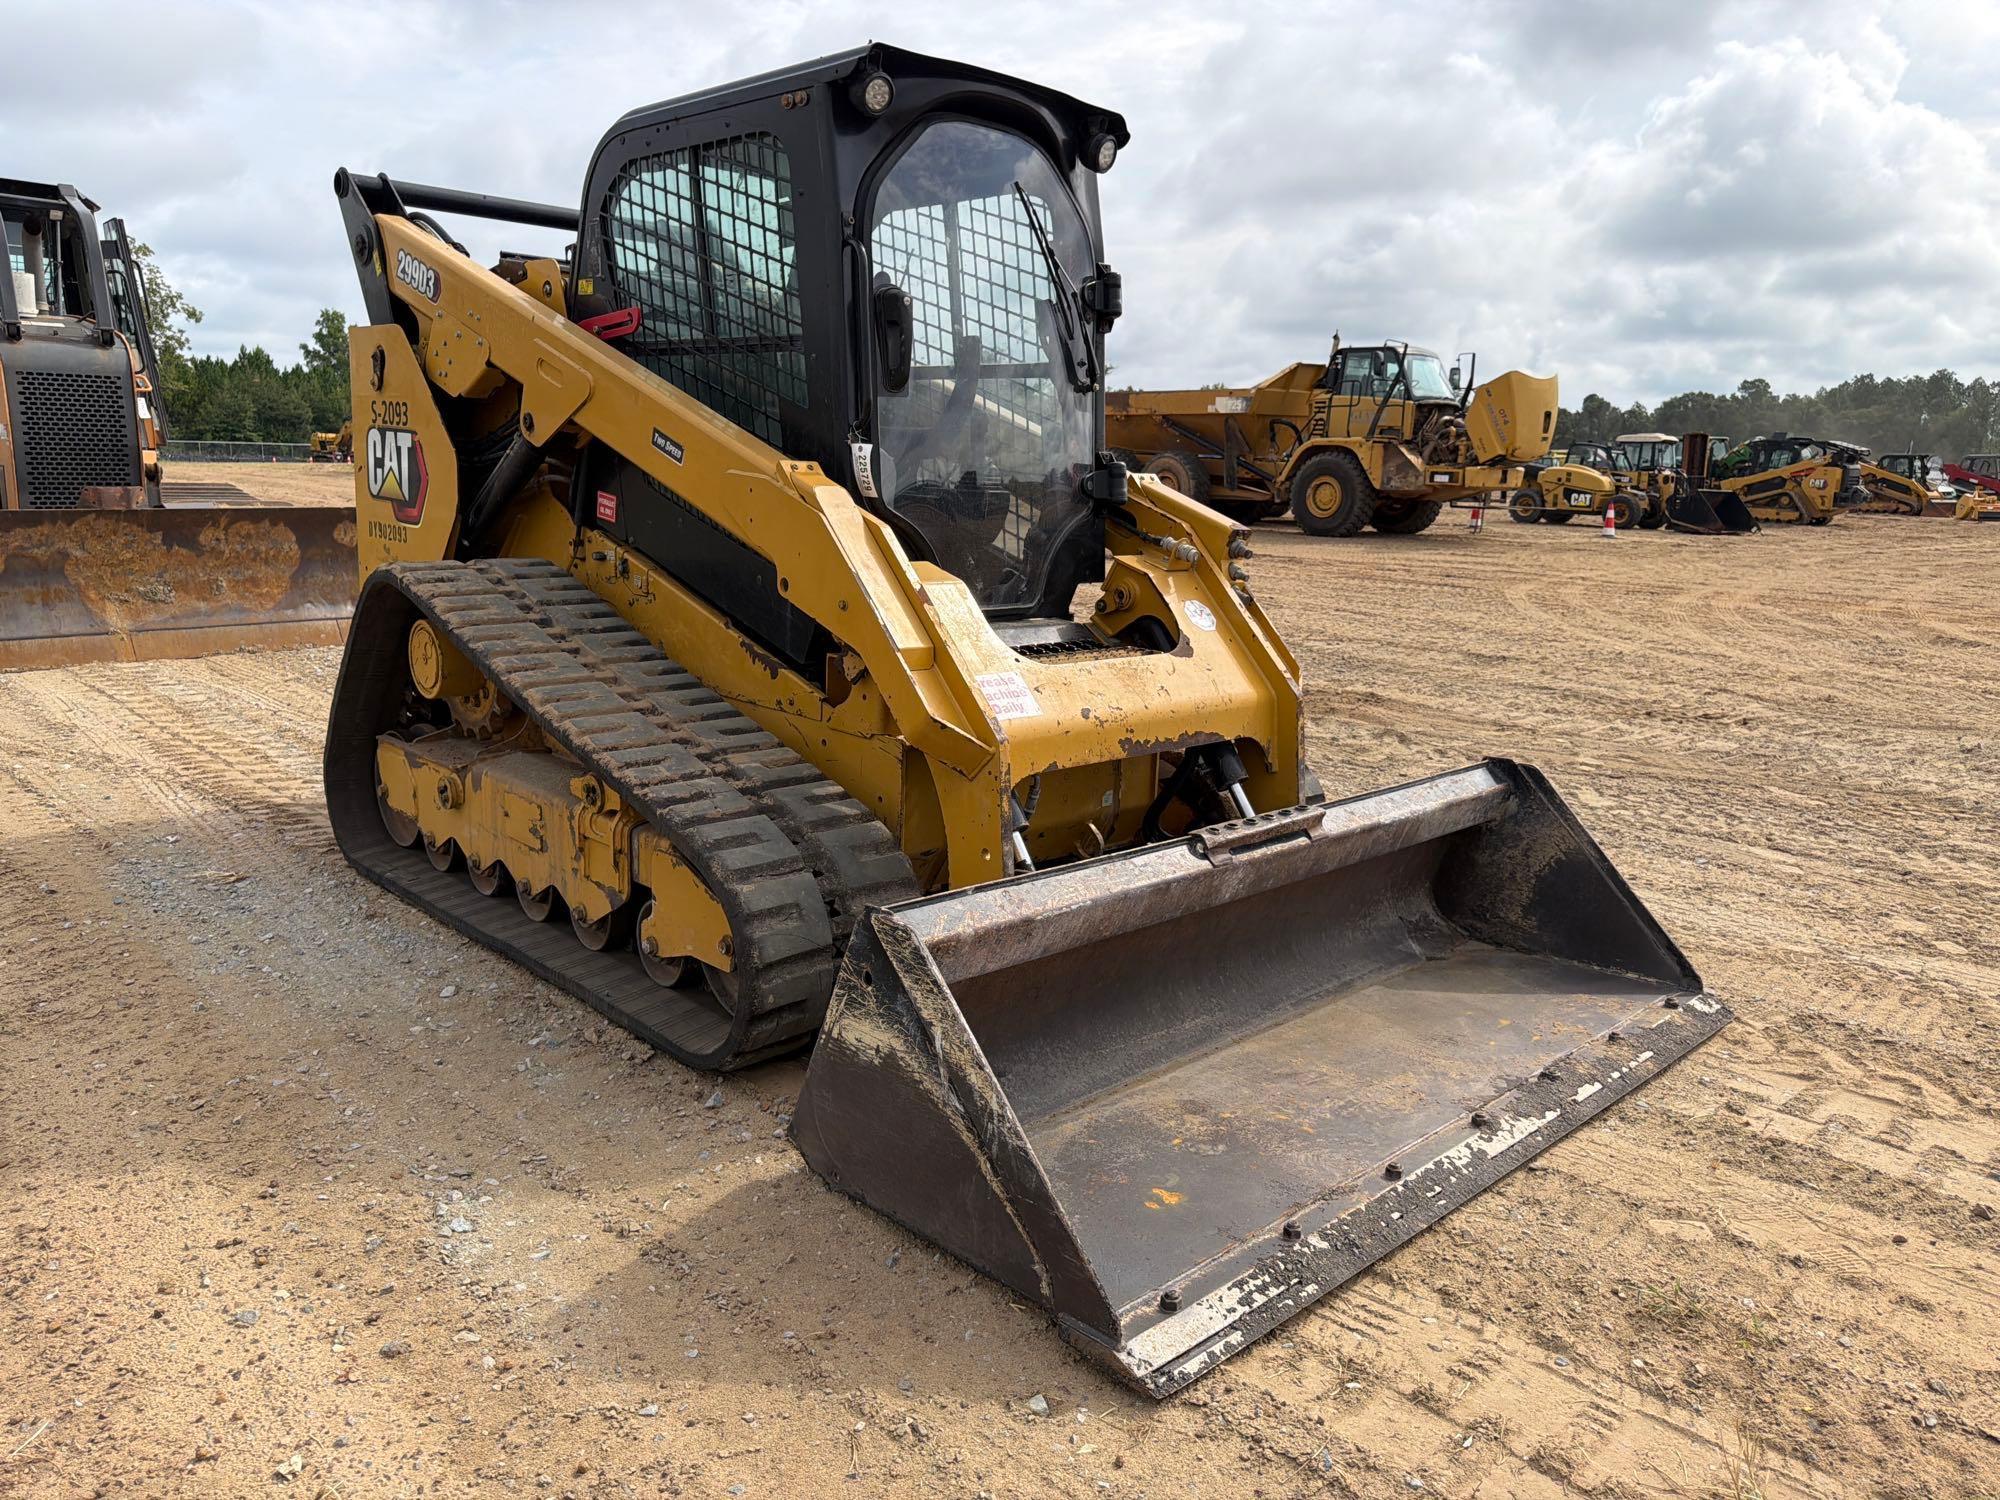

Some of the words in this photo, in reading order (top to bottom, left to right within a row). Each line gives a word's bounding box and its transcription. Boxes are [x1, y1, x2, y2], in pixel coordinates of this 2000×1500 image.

[397, 249, 435, 299] 299D3
[371, 401, 408, 426] S-2093
[368, 428, 411, 501] CAT
[859, 455, 872, 491] 225729
[1809, 478, 1825, 488] CAT
[1571, 493, 1592, 506] CAT
[368, 521, 408, 543] DY902093
[978, 677, 1015, 688] rease
[986, 689, 1027, 701] achine
[991, 702, 1024, 714] Daily
